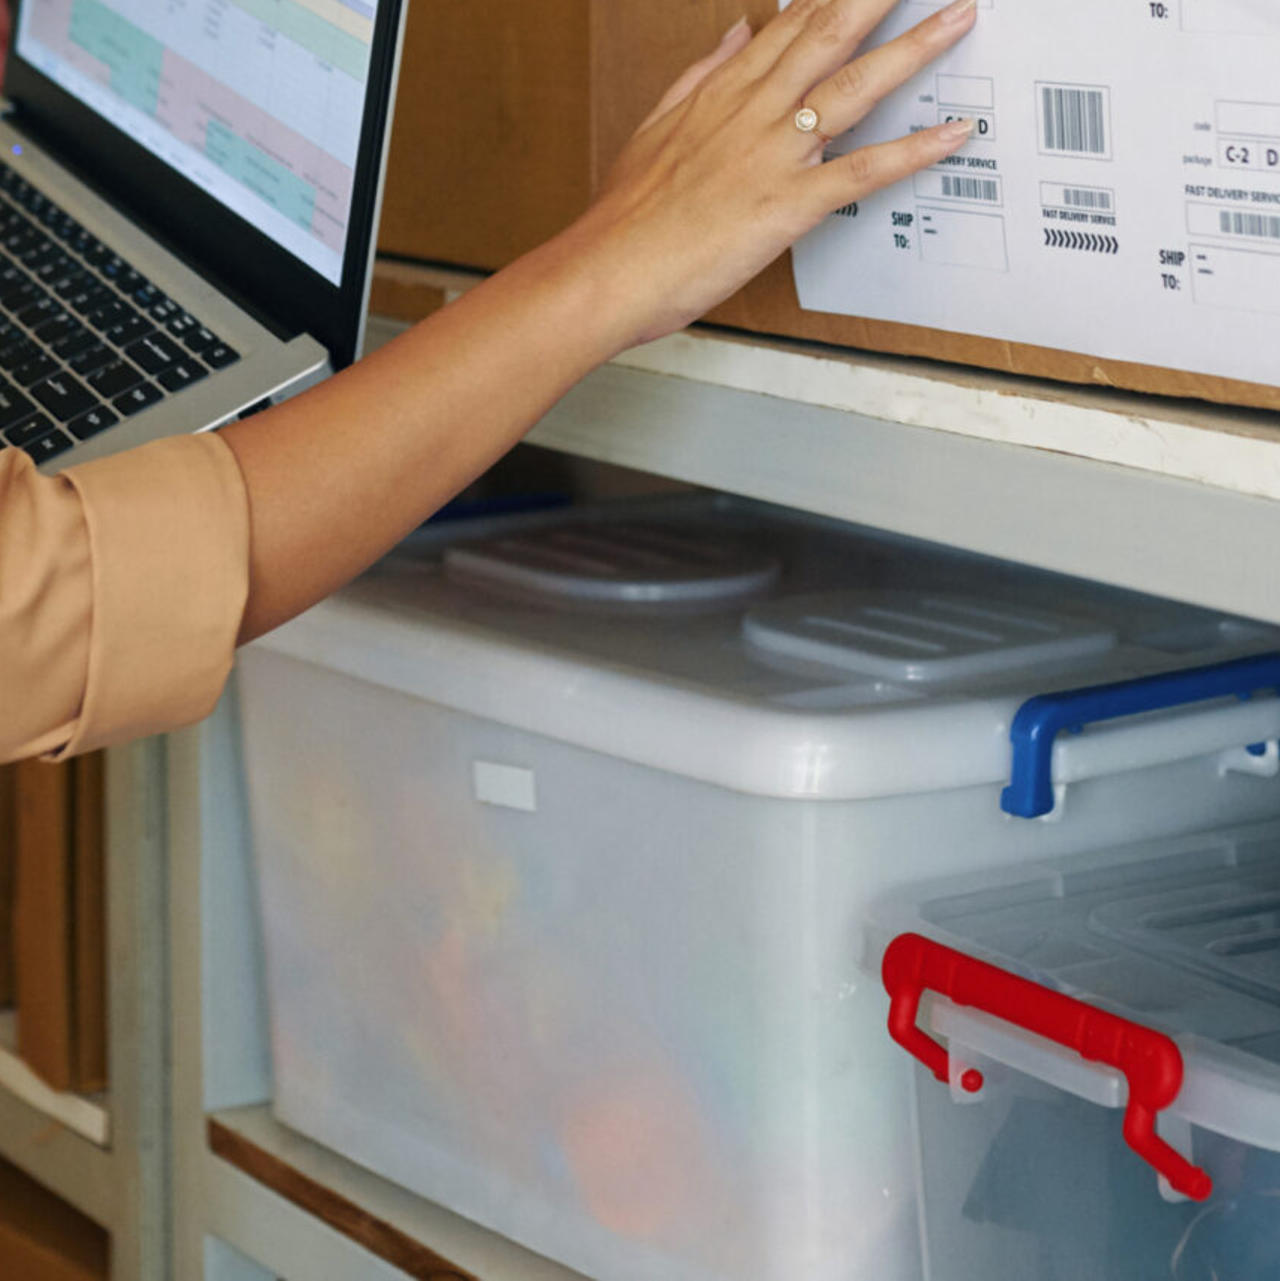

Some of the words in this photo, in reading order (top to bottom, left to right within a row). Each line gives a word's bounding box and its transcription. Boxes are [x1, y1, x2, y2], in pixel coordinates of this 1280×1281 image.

[1149, 2, 1169, 19] TO:
[967, 157, 997, 170] SERVICE
[1225, 145, 1250, 164] C-2
[1266, 148, 1279, 166] D
[1185, 184, 1205, 196] FAST
[1208, 186, 1248, 201] DELIVERY
[891, 211, 913, 227] SHIP
[893, 232, 910, 249] TO:
[1158, 249, 1185, 267] SHIP
[1160, 273, 1181, 291] TO:
